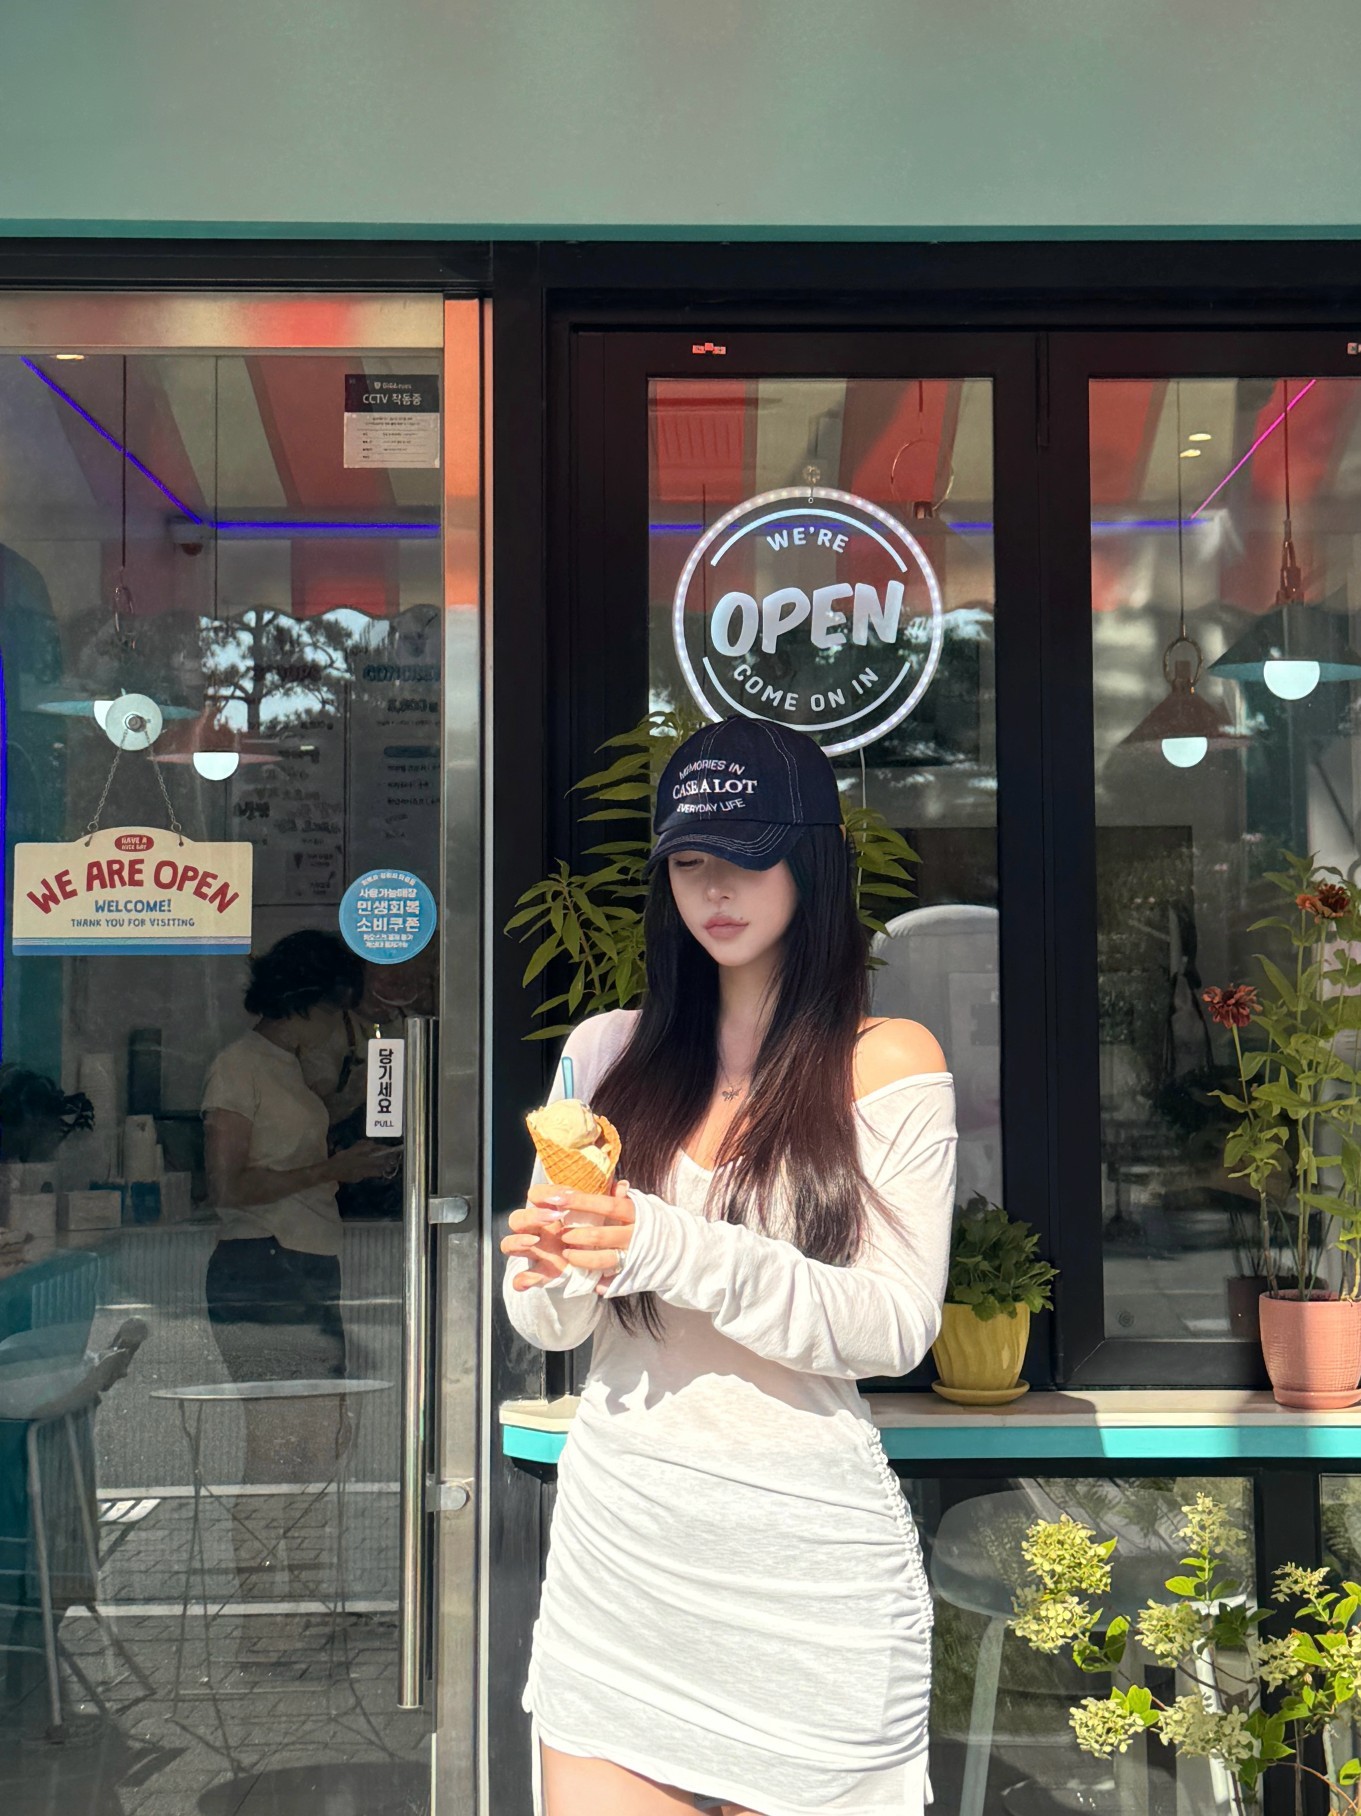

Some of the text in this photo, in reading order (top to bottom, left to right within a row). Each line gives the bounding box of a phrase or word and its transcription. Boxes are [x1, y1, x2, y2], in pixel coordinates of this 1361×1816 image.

[362, 393, 422, 406] CCTV 작동중
[710, 580, 905, 657] OPEN
[733, 664, 879, 712] COME ON IN
[679, 760, 745, 780] MEMORIES IN
[676, 798, 746, 814] EVERYDAY LIFE
[26, 858, 240, 915] WE ARE OPEN
[94, 898, 172, 913] WELCOME!
[357, 900, 420, 915] 민생회복
[71, 917, 195, 928] THANK YOU FOR VISITING
[357, 917, 420, 932] 소비쿠폰
[377, 1048, 394, 1114] 당기세요
[374, 1120, 394, 1128] PULL
